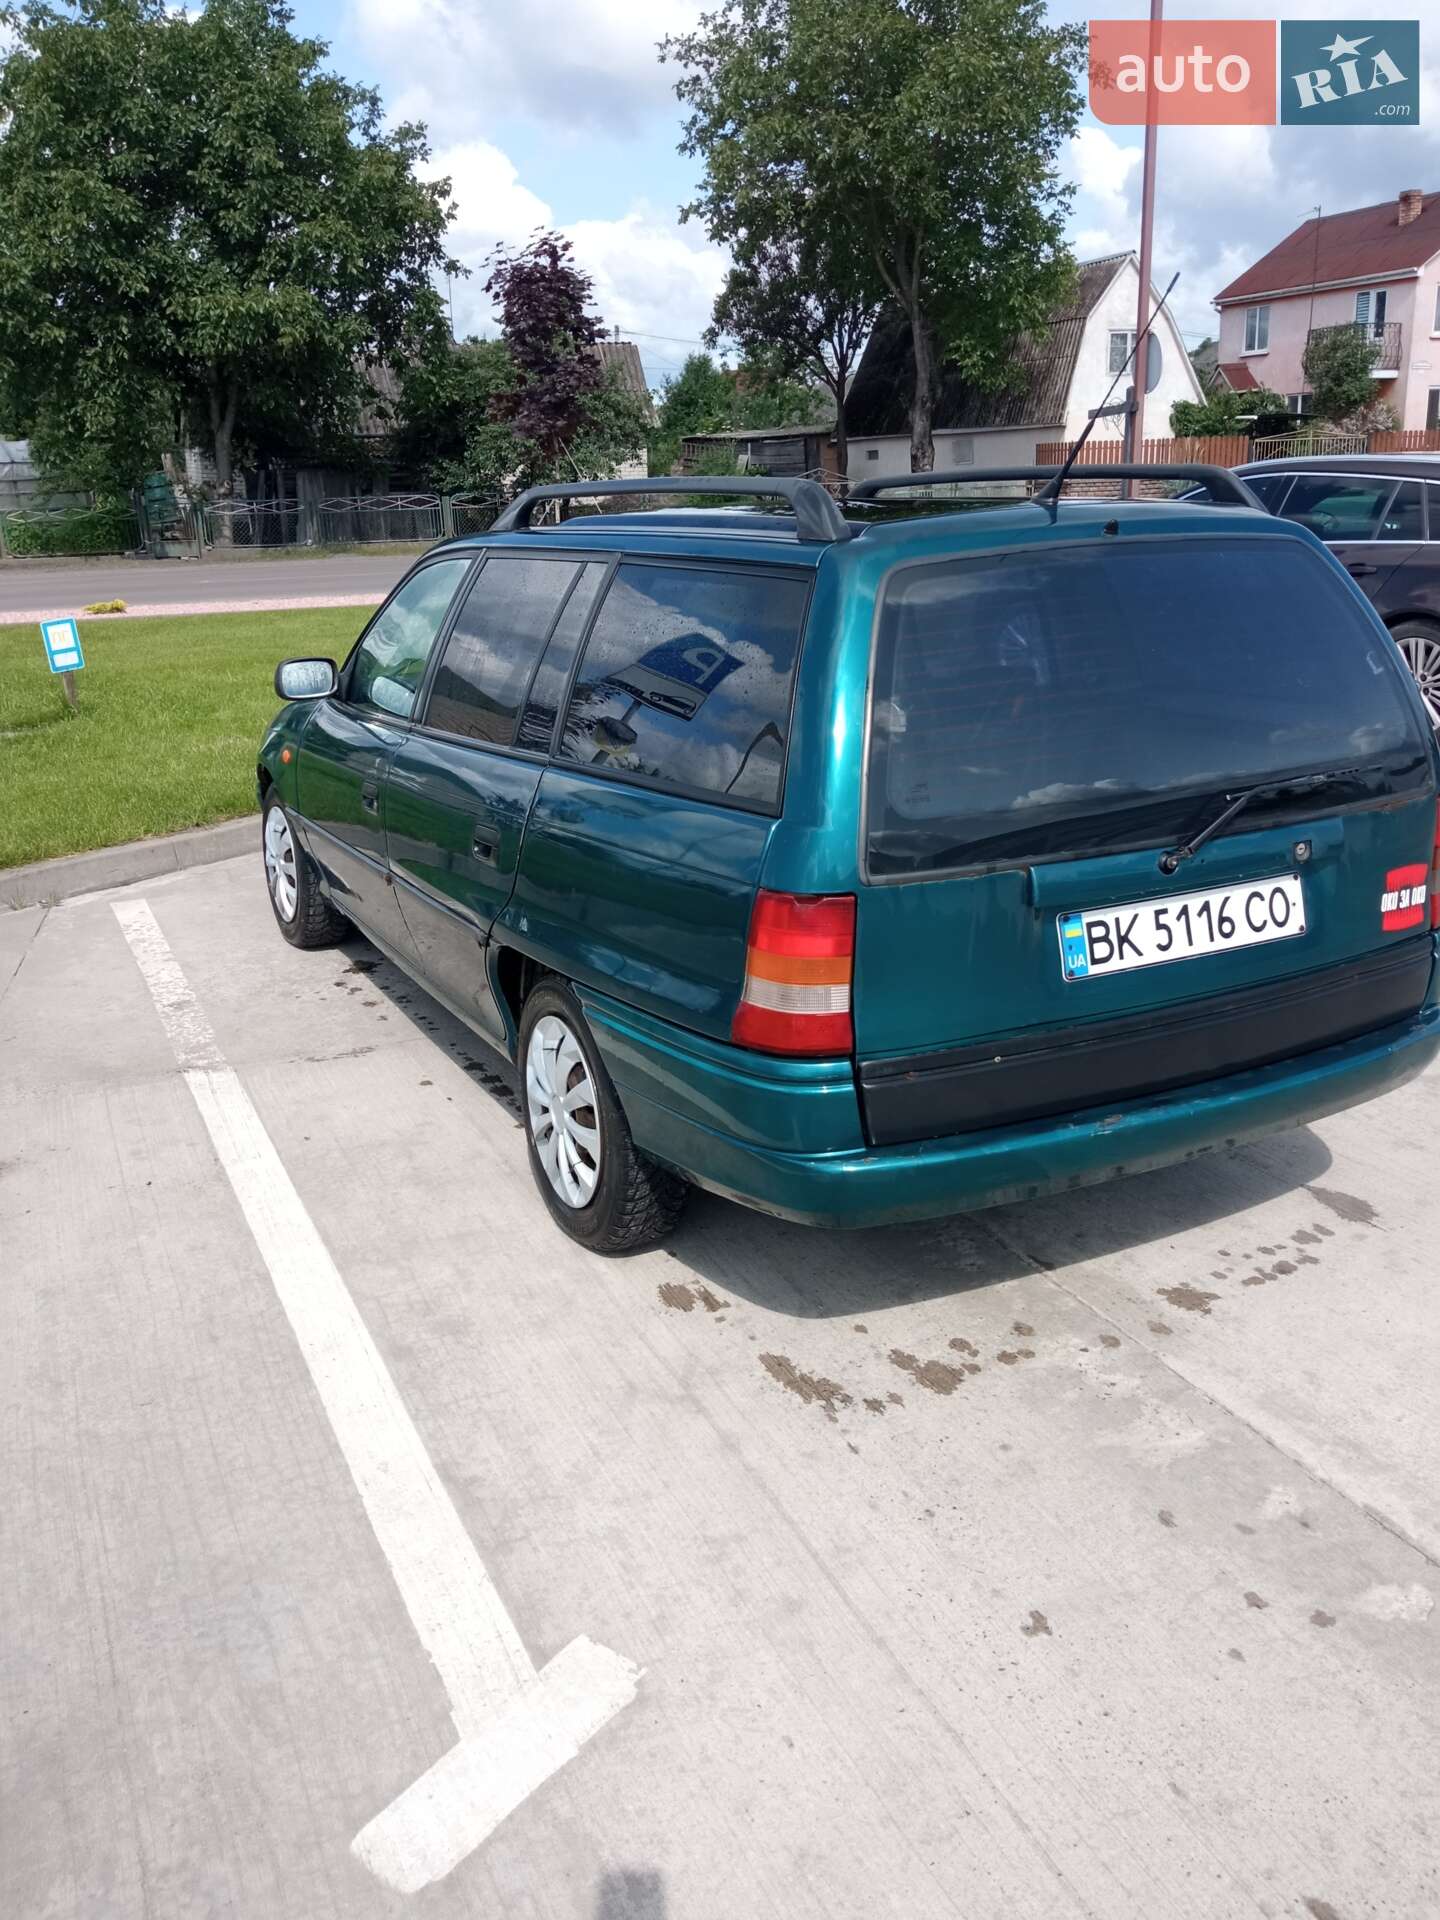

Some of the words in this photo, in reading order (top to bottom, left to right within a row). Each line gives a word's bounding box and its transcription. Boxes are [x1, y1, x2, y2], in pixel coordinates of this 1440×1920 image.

[1086, 913, 1144, 966] BK
[1154, 896, 1235, 952] 5116
[1245, 886, 1290, 933] CO
[1068, 953, 1087, 968] UA
